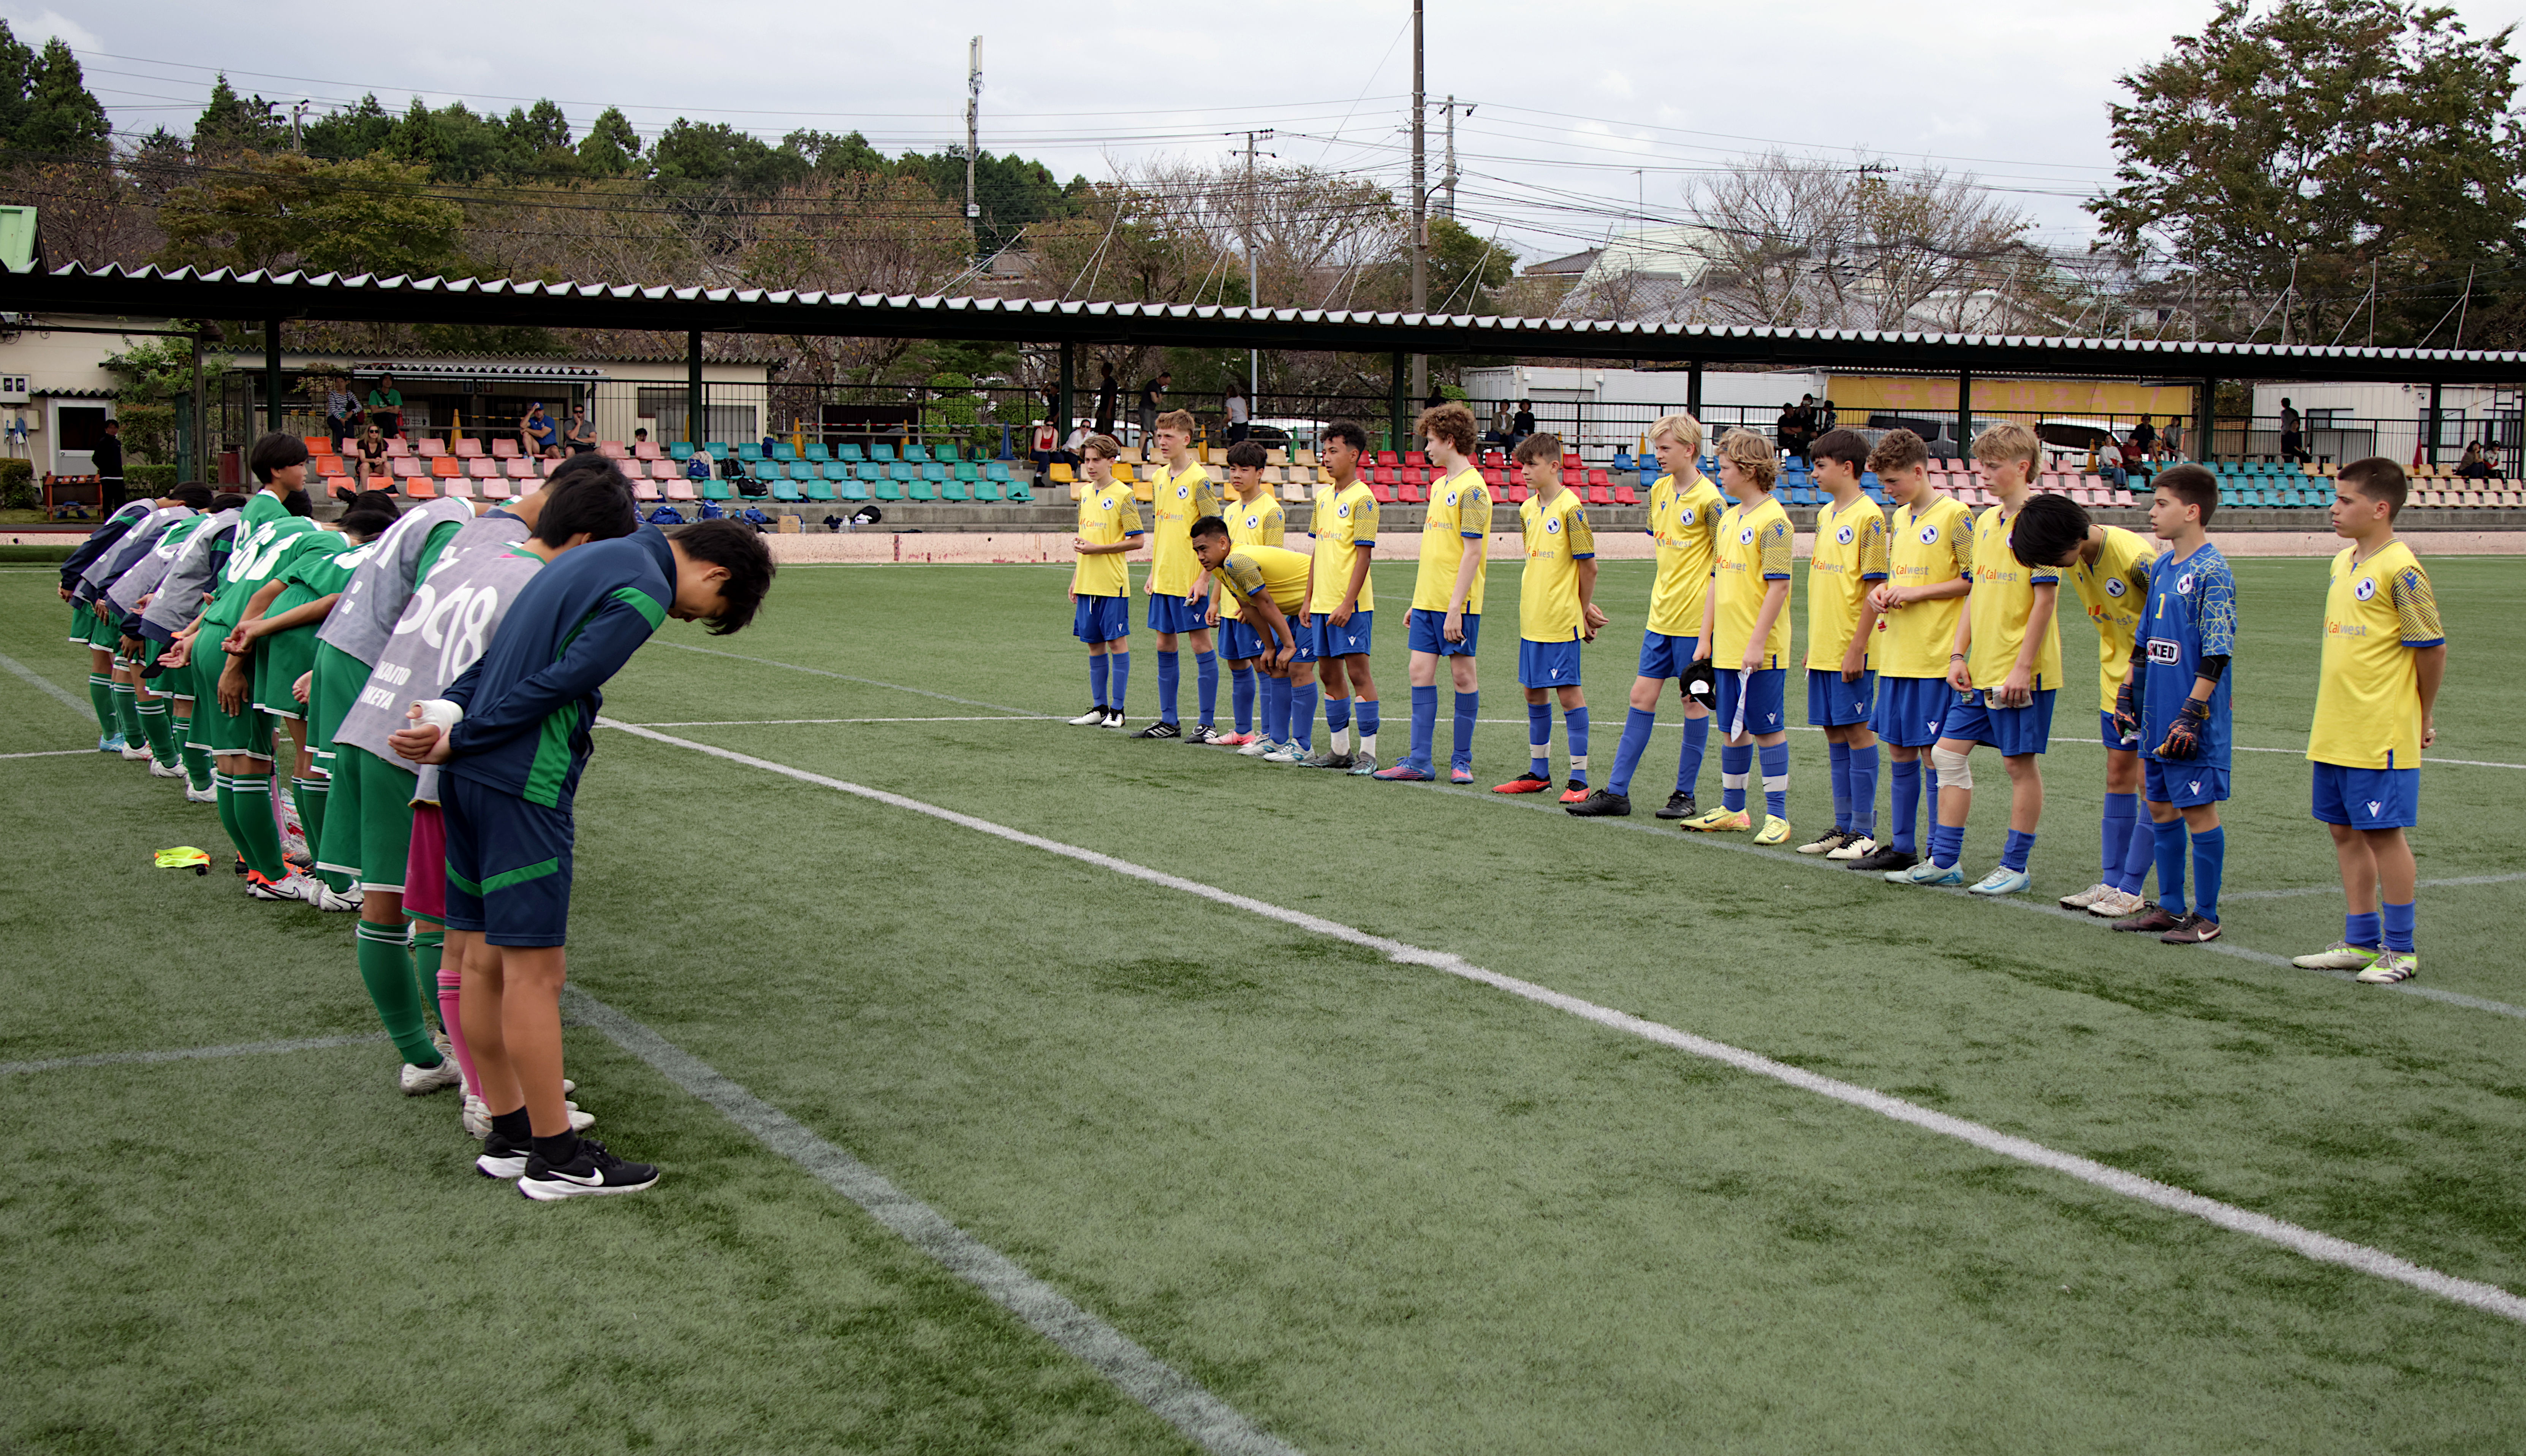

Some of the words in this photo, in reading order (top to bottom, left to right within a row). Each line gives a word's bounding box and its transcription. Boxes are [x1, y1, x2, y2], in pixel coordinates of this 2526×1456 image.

[1896, 564, 1929, 575] Calwest
[1986, 569, 2017, 582] Calwest
[2155, 593, 2165, 619] 1
[2328, 621, 2367, 636] Calwest
[374, 661, 412, 685] KAITO
[361, 685, 396, 710] IKEYA
